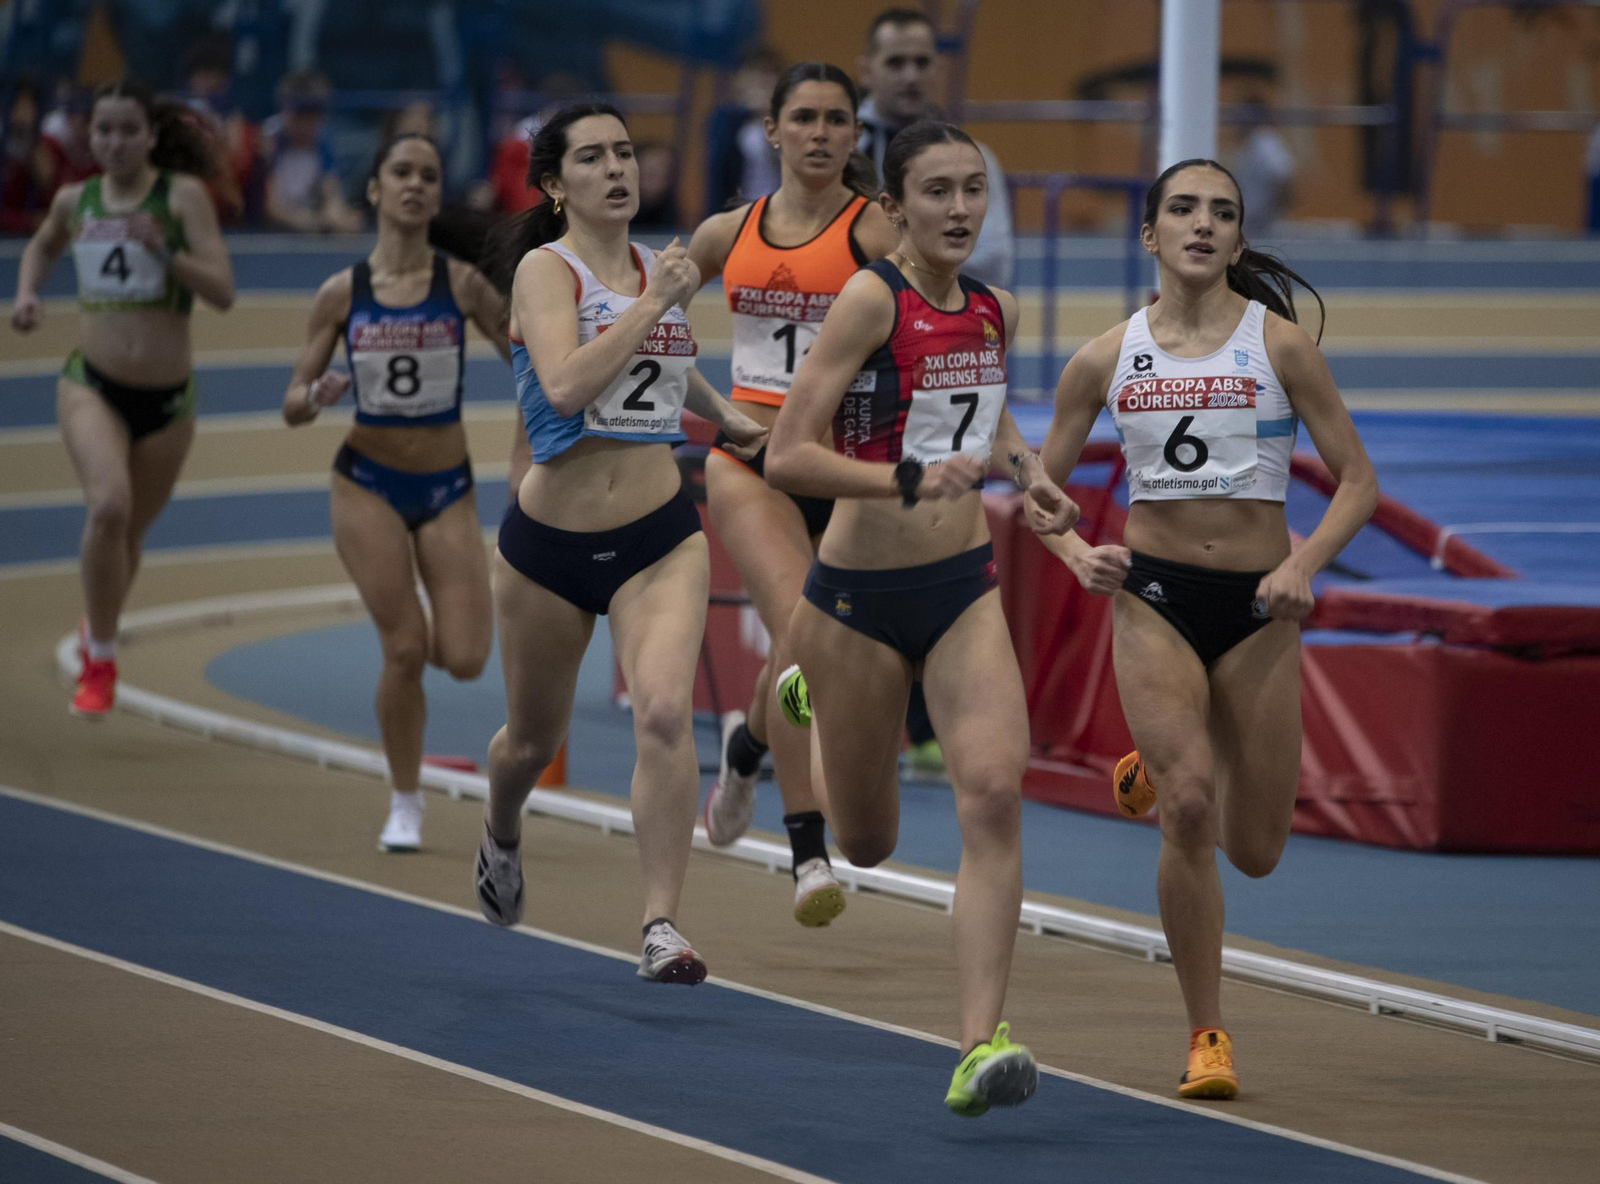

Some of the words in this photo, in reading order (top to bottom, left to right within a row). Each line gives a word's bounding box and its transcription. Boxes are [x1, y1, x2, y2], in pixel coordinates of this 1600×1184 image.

[101, 246, 131, 282] 4
[739, 287, 763, 301] XXI
[765, 290, 805, 306] COPA
[738, 301, 802, 319] OURENSE
[925, 354, 945, 370] XXI
[947, 352, 978, 369] COPA
[980, 350, 999, 367] ABS
[387, 355, 421, 399] 8
[623, 359, 662, 411] 2
[922, 369, 978, 388] OURENSE
[1132, 380, 1157, 395] XXI
[1161, 378, 1207, 393] COPA
[1211, 378, 1244, 392] ABS
[844, 397, 856, 416] DE
[1126, 393, 1203, 410] OURENSE
[1207, 392, 1248, 407] 2026
[609, 416, 663, 430] atletismo.gal
[858, 397, 872, 444] XUNTA
[950, 392, 979, 452] 7
[1163, 415, 1209, 473] 6
[1152, 477, 1218, 491] atletismo.gal
